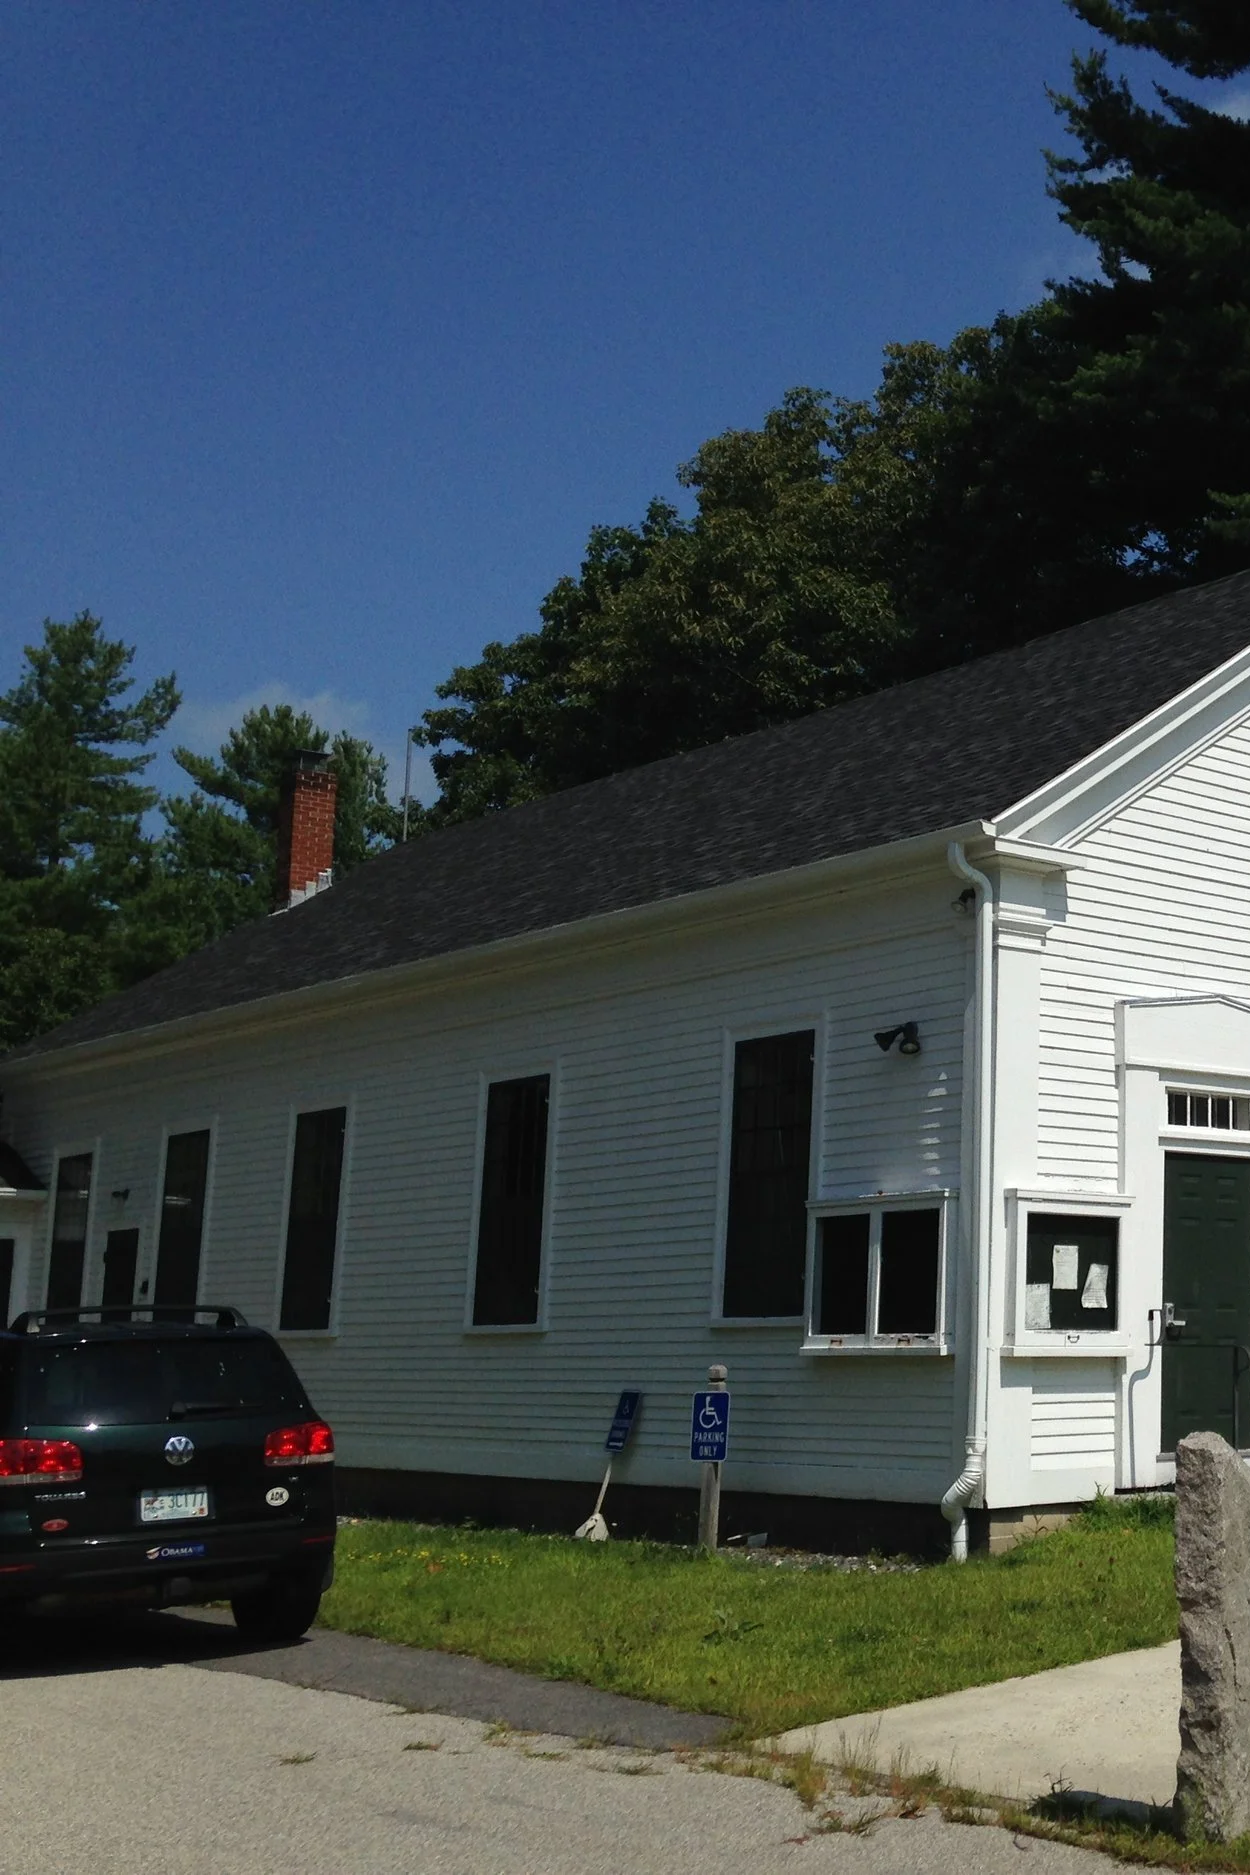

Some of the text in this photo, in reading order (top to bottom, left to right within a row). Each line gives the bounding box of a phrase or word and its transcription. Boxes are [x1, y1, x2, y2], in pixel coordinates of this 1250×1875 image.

[694, 1431, 724, 1443] PARKING
[699, 1445, 718, 1457] ONLY
[270, 1490, 285, 1501] ADK
[161, 1547, 193, 1557] OBAMA
